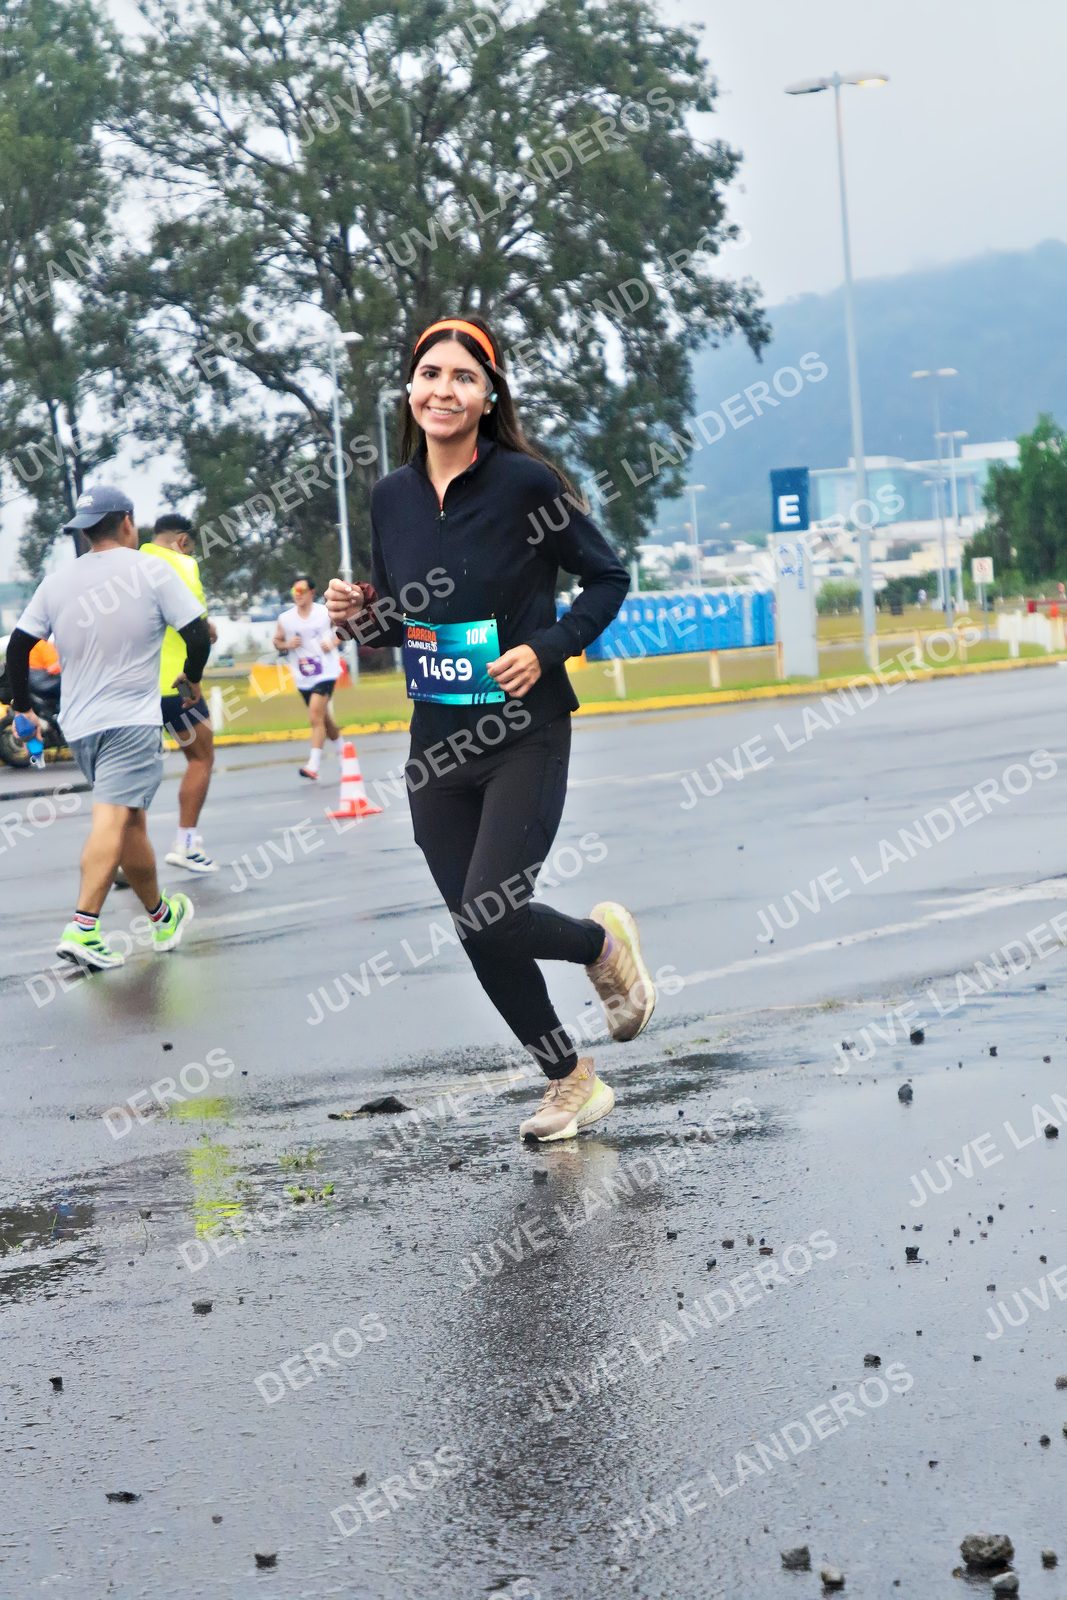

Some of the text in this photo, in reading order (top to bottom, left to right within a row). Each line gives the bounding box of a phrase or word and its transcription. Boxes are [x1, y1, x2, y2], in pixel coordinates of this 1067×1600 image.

[778, 494, 801, 525] E
[407, 626, 437, 642] CARRERA
[466, 627, 488, 645] 10K
[418, 655, 473, 681] 1469
